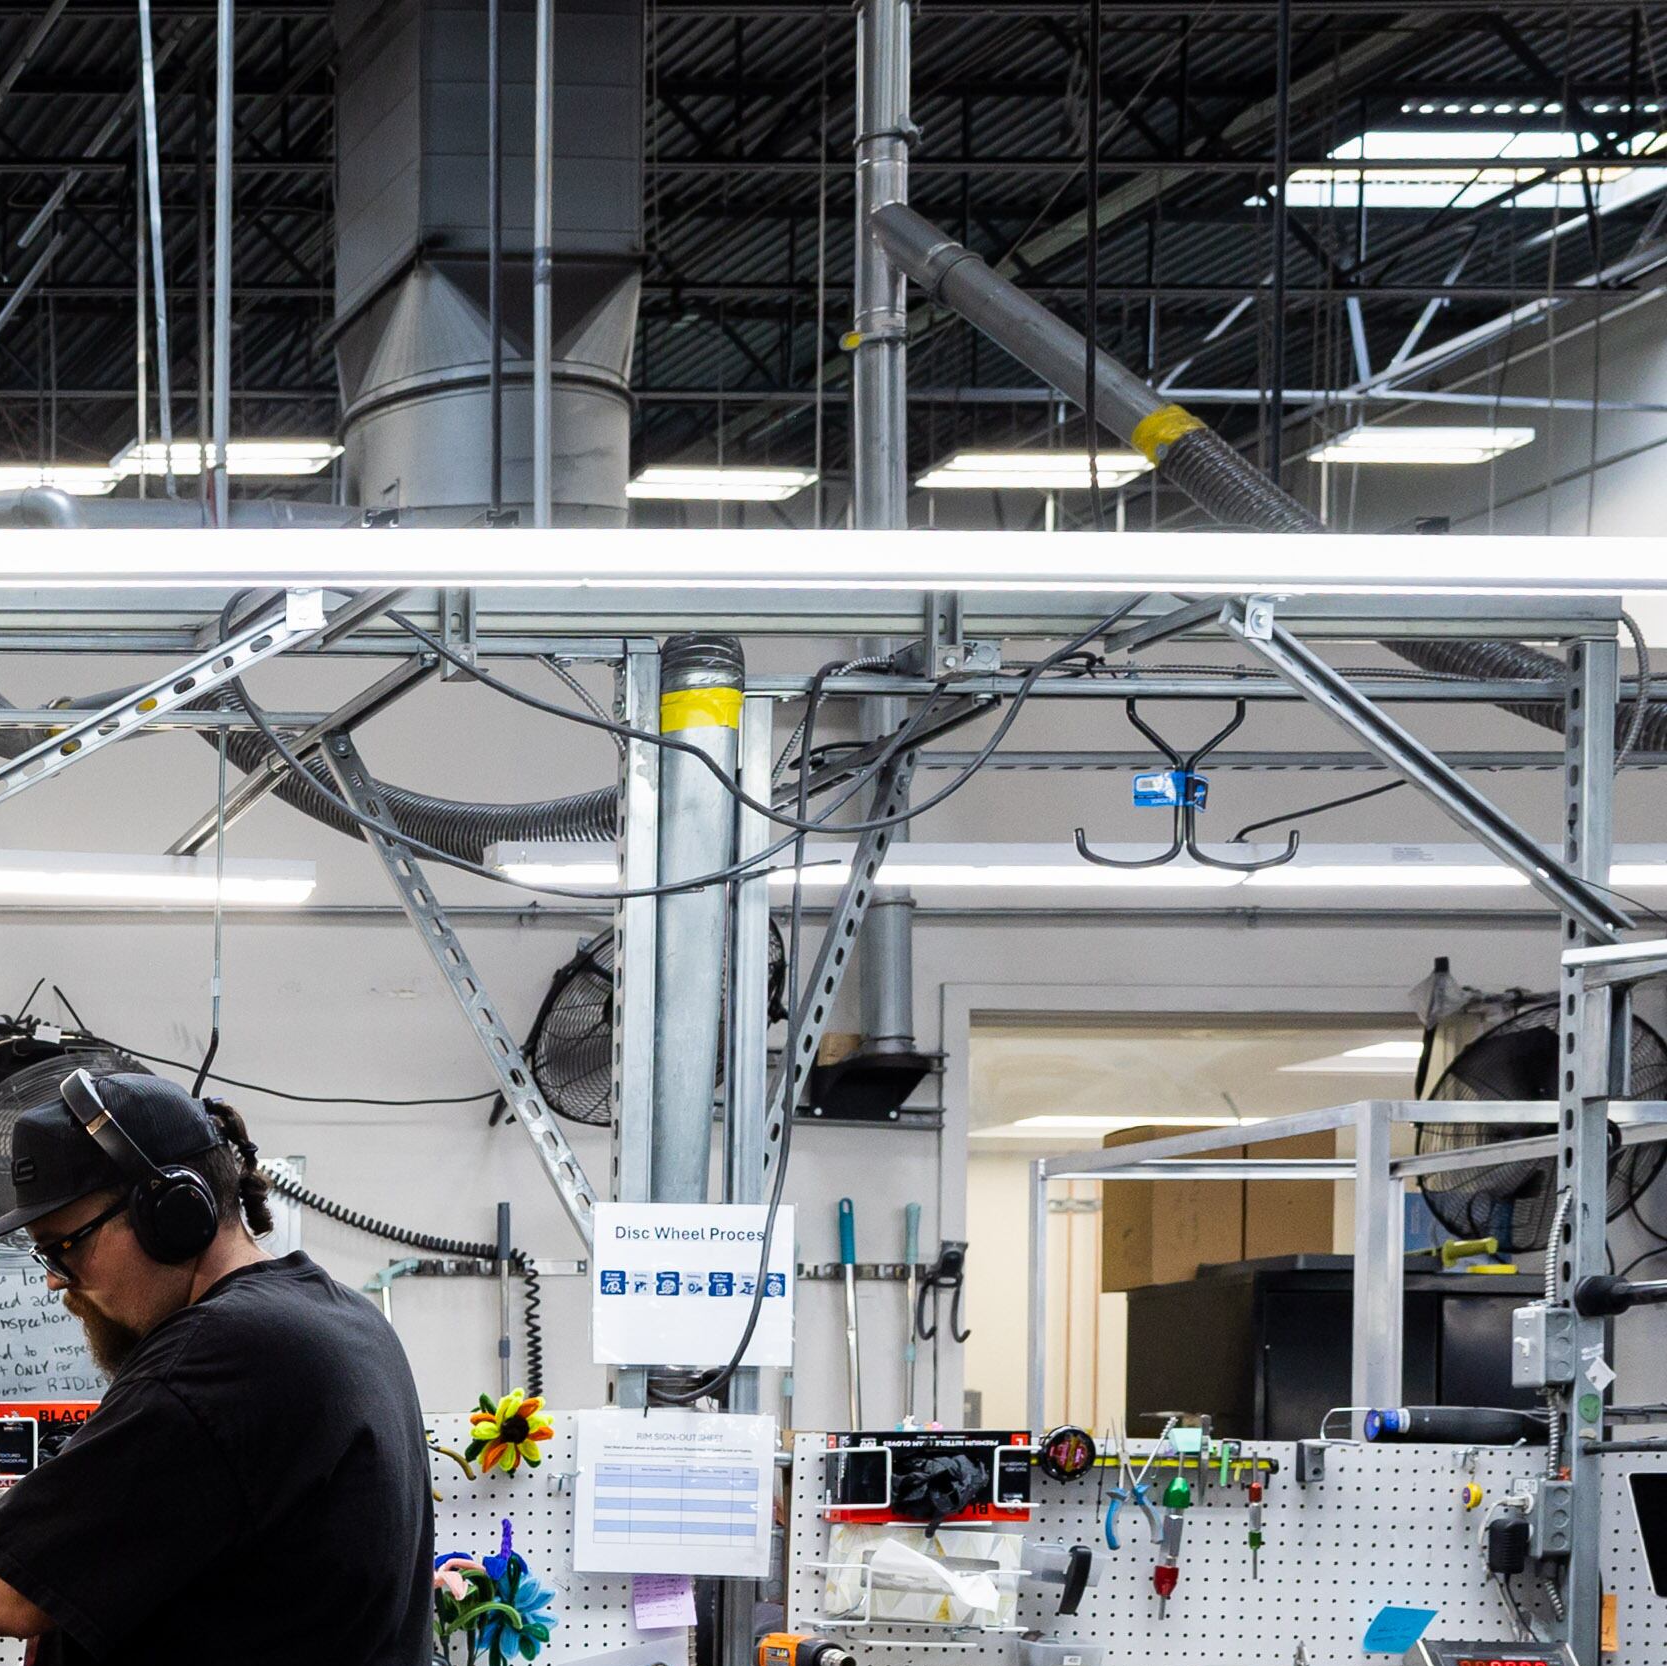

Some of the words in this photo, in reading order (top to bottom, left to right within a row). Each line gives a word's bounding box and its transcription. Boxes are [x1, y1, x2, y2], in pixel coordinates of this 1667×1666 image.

[615, 1226, 650, 1240] Disc
[654, 1226, 706, 1240] Wheel
[24, 1345, 38, 1358] to
[14, 1360, 49, 1377] ONLY
[55, 1361, 75, 1372] for
[636, 1432, 653, 1441] RIM
[653, 1432, 697, 1442] SIGN-OUT
[883, 1439, 912, 1447] GLOVES
